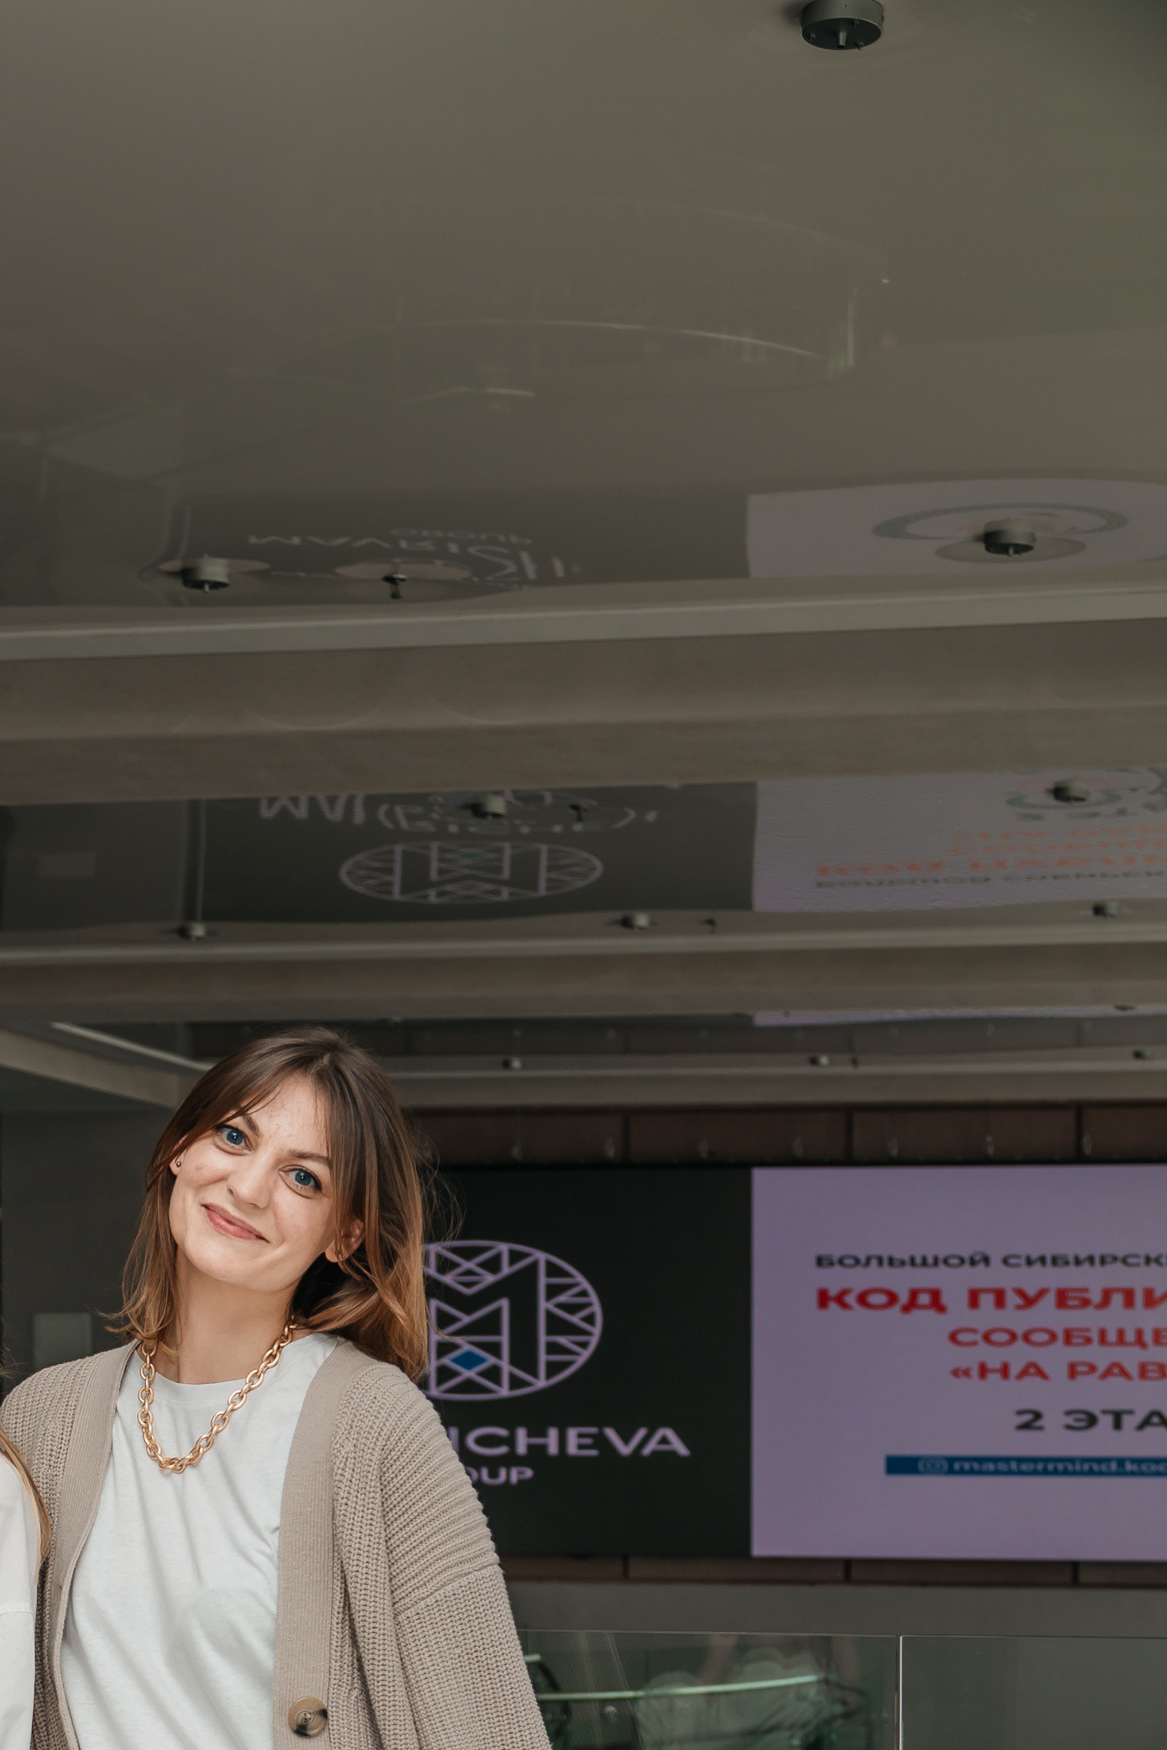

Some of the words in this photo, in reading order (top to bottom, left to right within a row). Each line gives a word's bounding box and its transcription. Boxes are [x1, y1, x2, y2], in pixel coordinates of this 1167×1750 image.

[815, 1251, 991, 1269] БОЛЬШОЙ
[816, 1287, 948, 1315] КОД
[950, 1361, 1050, 1381] «НА
[1067, 1361, 1167, 1381] РАВ
[1014, 1408, 1045, 1431] 2
[1062, 1408, 1167, 1432] ЭТА
